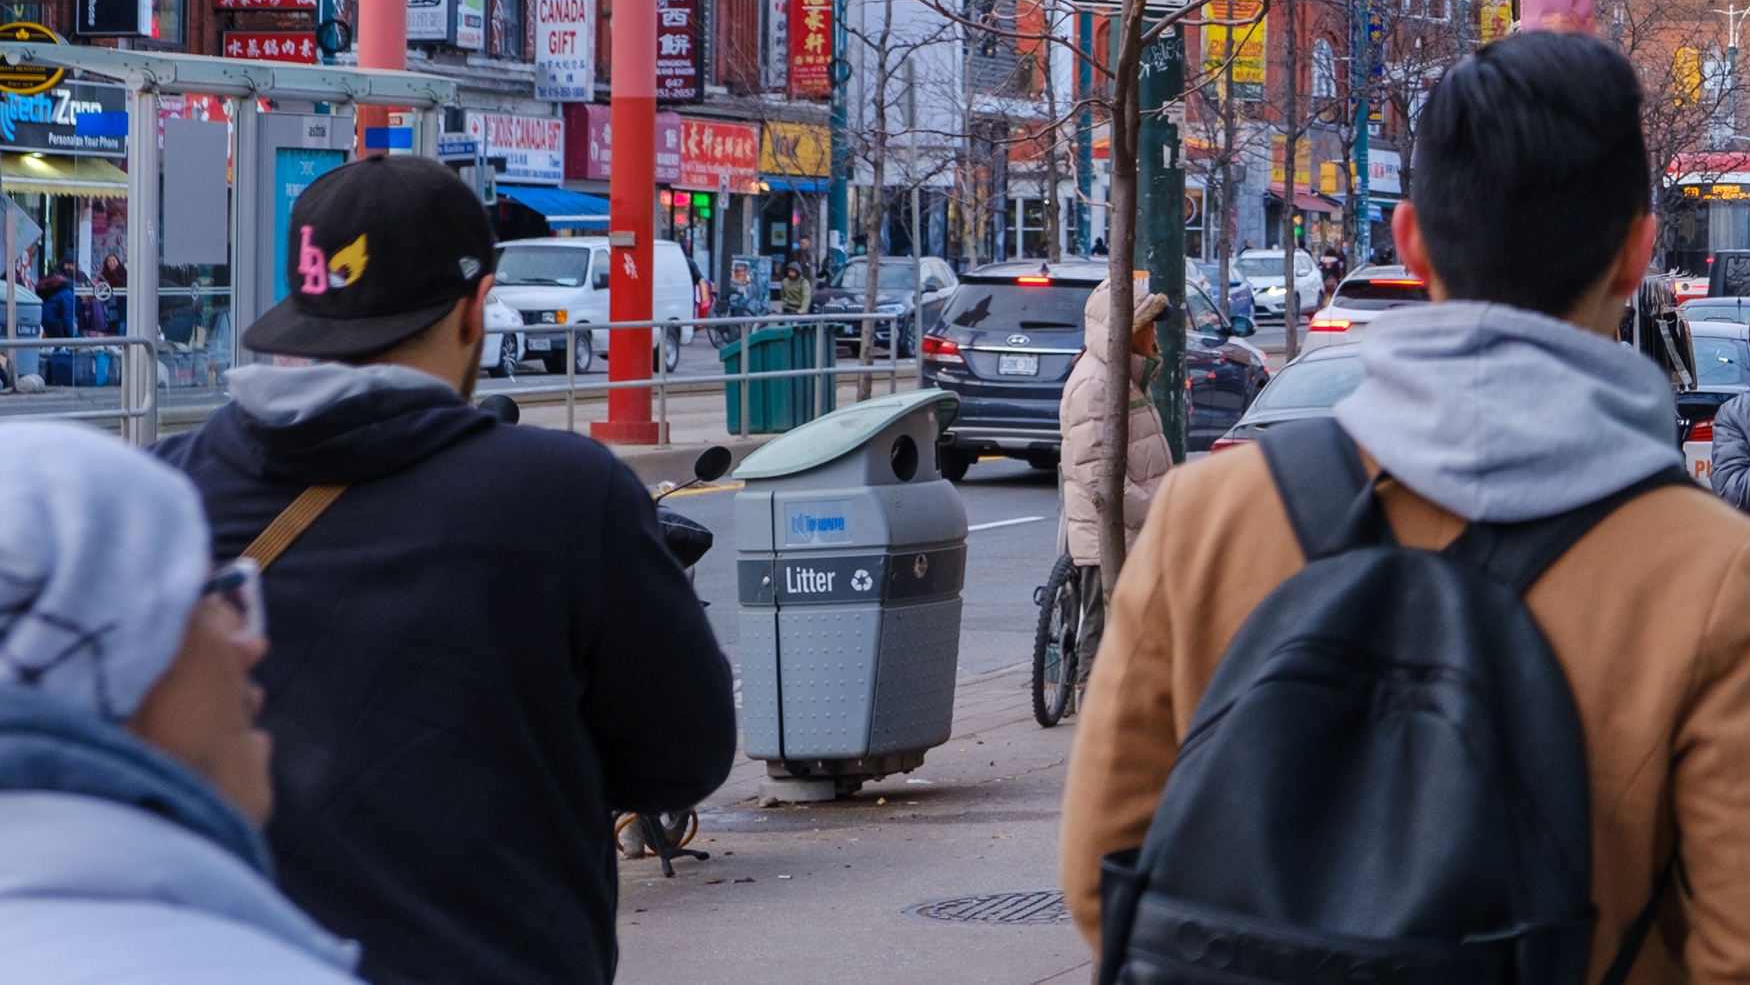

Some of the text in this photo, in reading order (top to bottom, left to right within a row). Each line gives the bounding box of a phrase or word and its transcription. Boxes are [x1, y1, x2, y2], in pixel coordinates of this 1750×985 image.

[549, 31, 577, 55] GIFT
[665, 79, 683, 88] 647
[84, 135, 99, 148] Your
[100, 135, 119, 149] Phone
[804, 516, 845, 532] TORONTO
[785, 566, 836, 594] Litter
